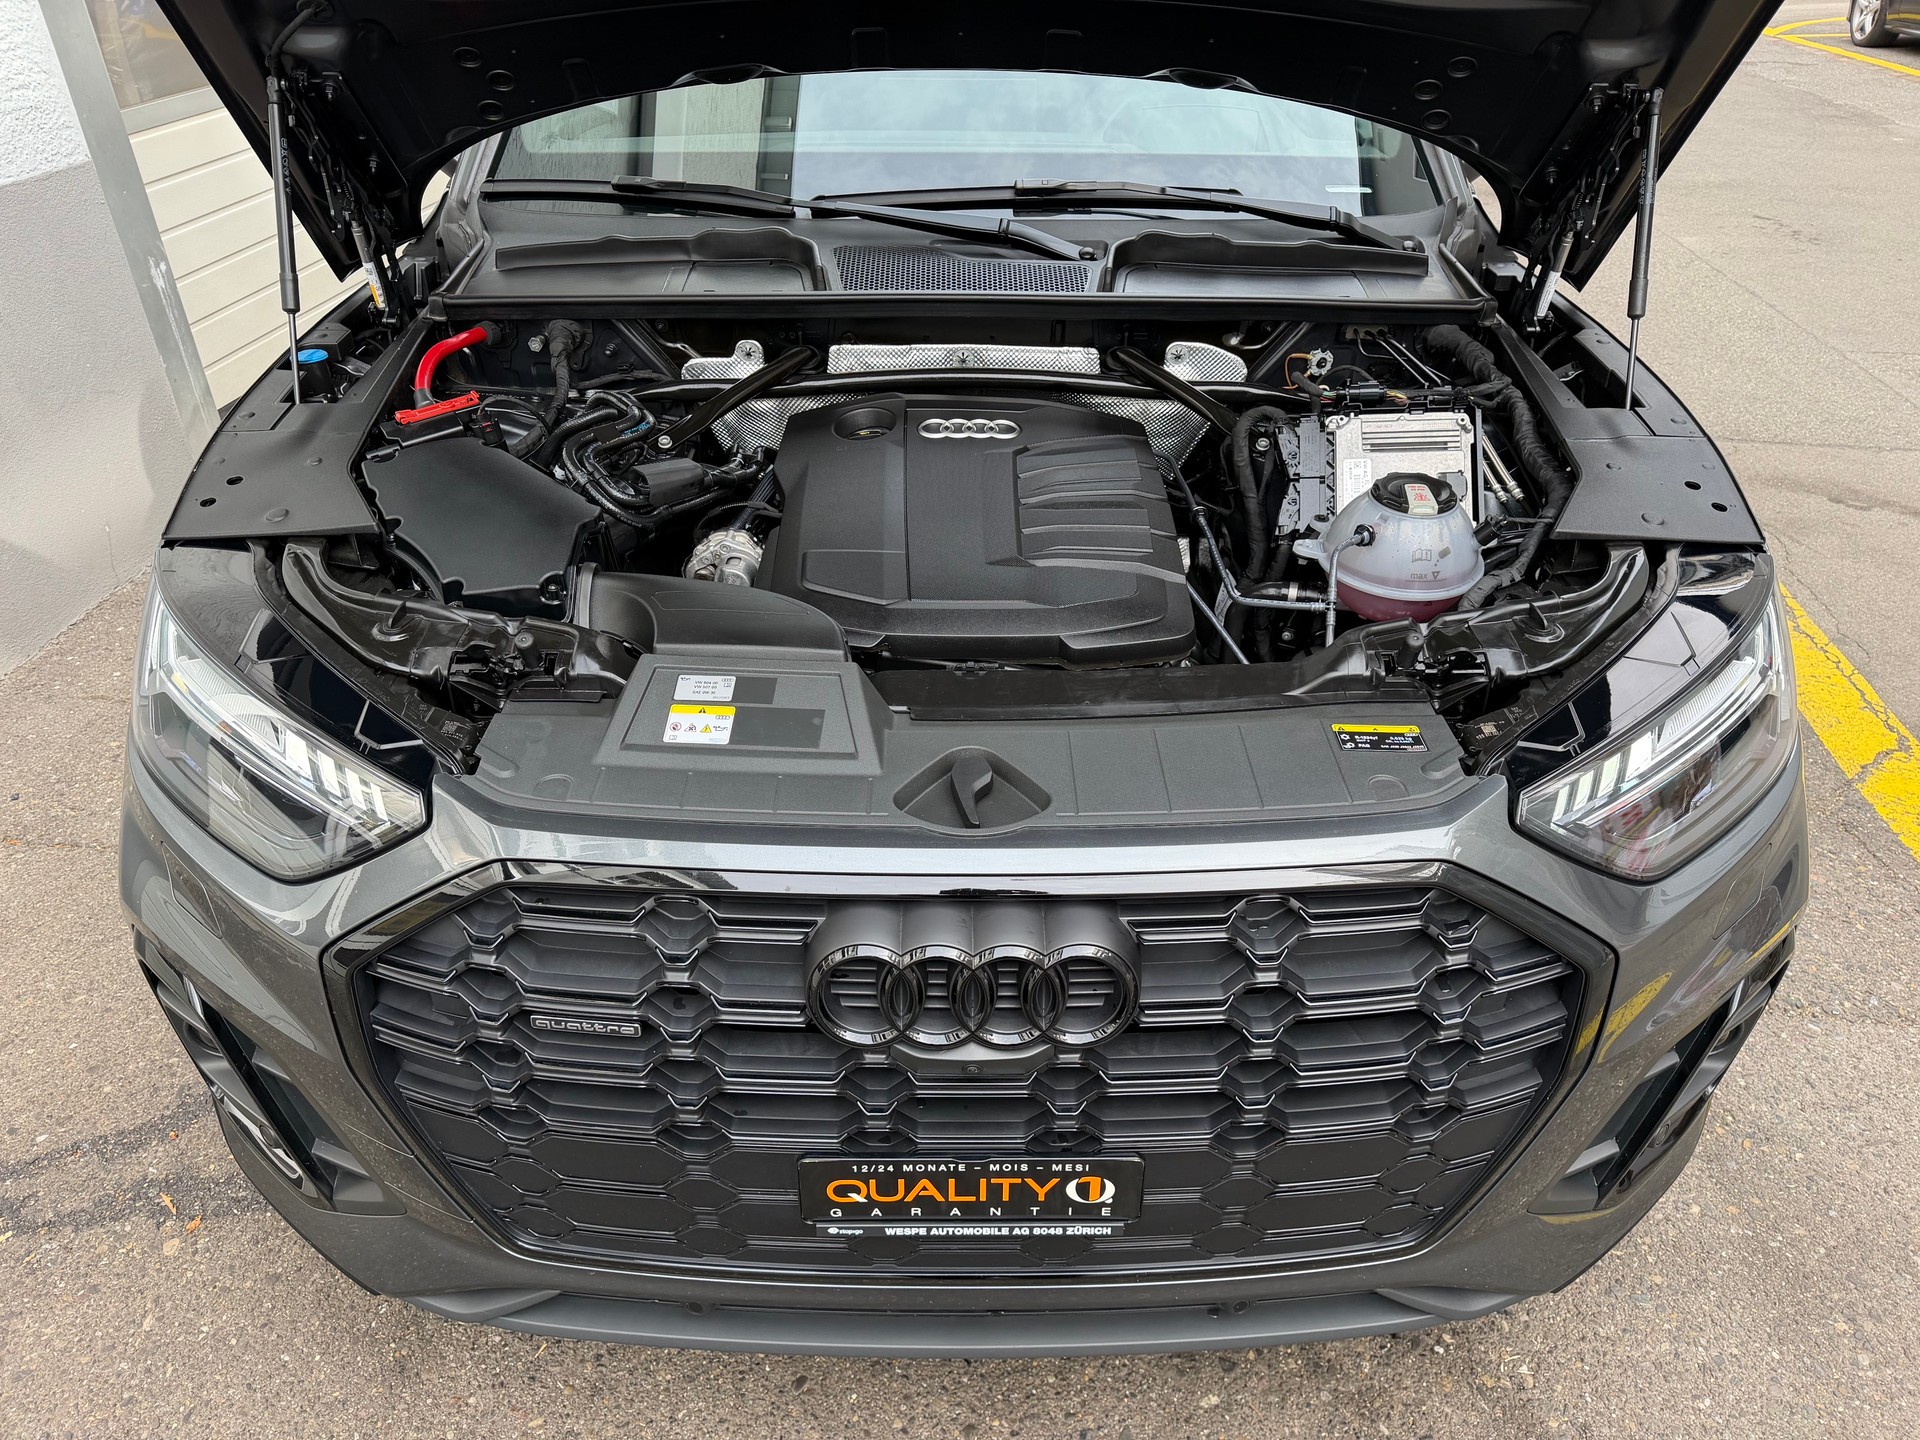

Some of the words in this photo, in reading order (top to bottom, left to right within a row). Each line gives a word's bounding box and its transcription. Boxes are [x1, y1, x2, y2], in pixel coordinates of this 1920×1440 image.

[535, 1018, 635, 1035] quattro
[852, 1163, 895, 1173] 12/24
[902, 1163, 967, 1172] MONATE
[989, 1163, 1028, 1172] MOIS
[1052, 1163, 1091, 1172] MESI
[825, 1177, 1061, 1203] QUALITY
[830, 1206, 1112, 1217] GARANTIE
[884, 1227, 928, 1236] WESPE
[930, 1227, 1010, 1236] AUTOMOBILE
[1012, 1227, 1031, 1236] AG
[1032, 1227, 1064, 1236] 8048
[1066, 1225, 1112, 1236] ZÜRICH
